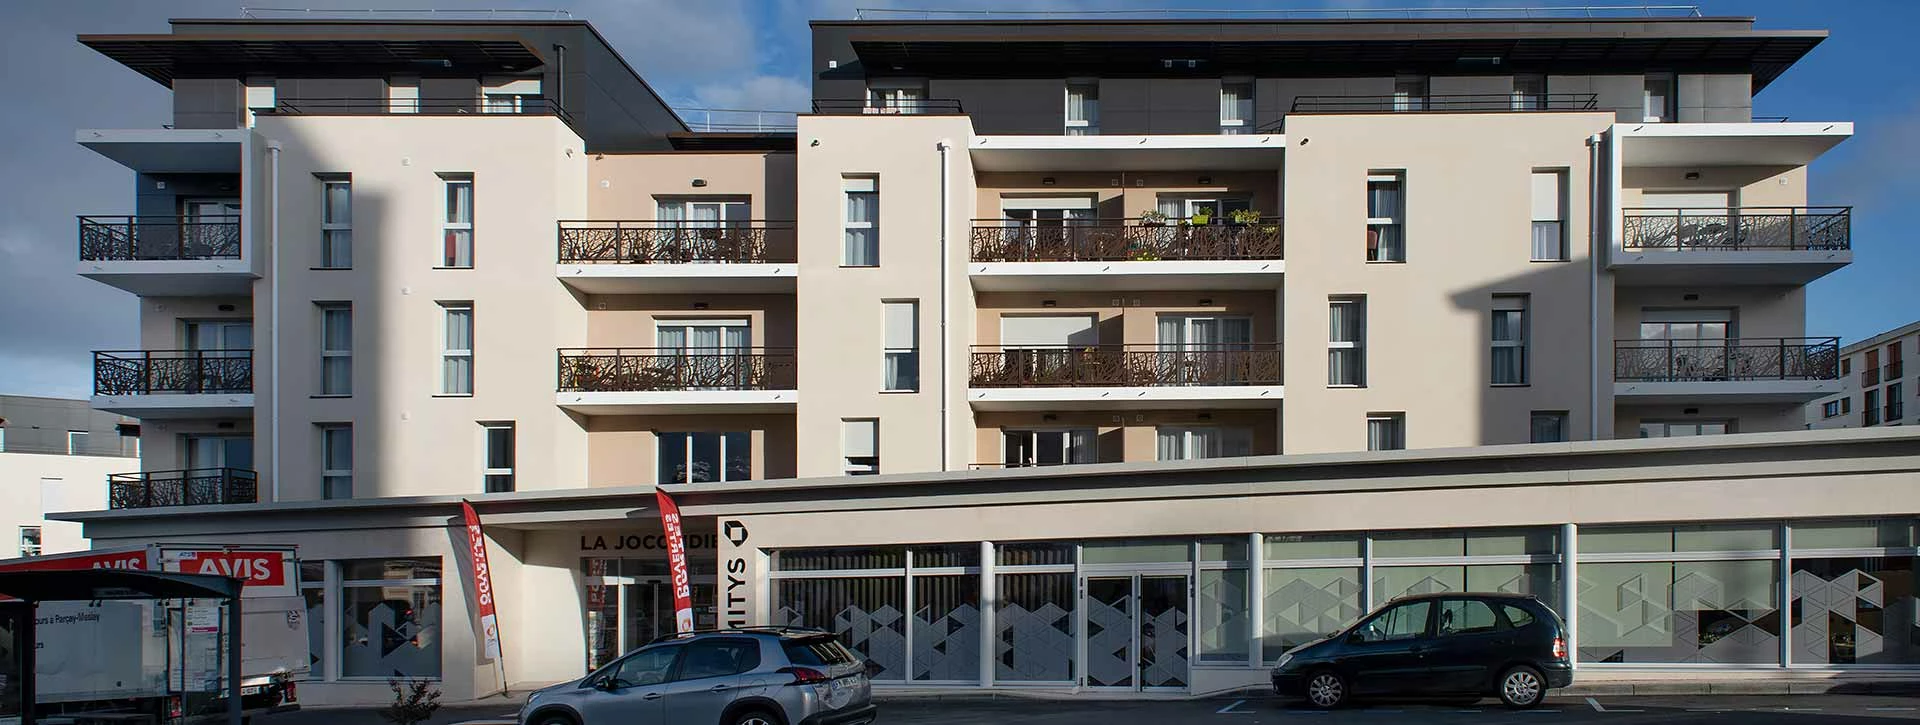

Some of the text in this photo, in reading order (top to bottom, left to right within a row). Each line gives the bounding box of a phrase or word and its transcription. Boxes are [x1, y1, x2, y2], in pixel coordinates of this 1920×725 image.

[581, 533, 717, 551] LA JOCODIE
[199, 558, 271, 580] AVIS
